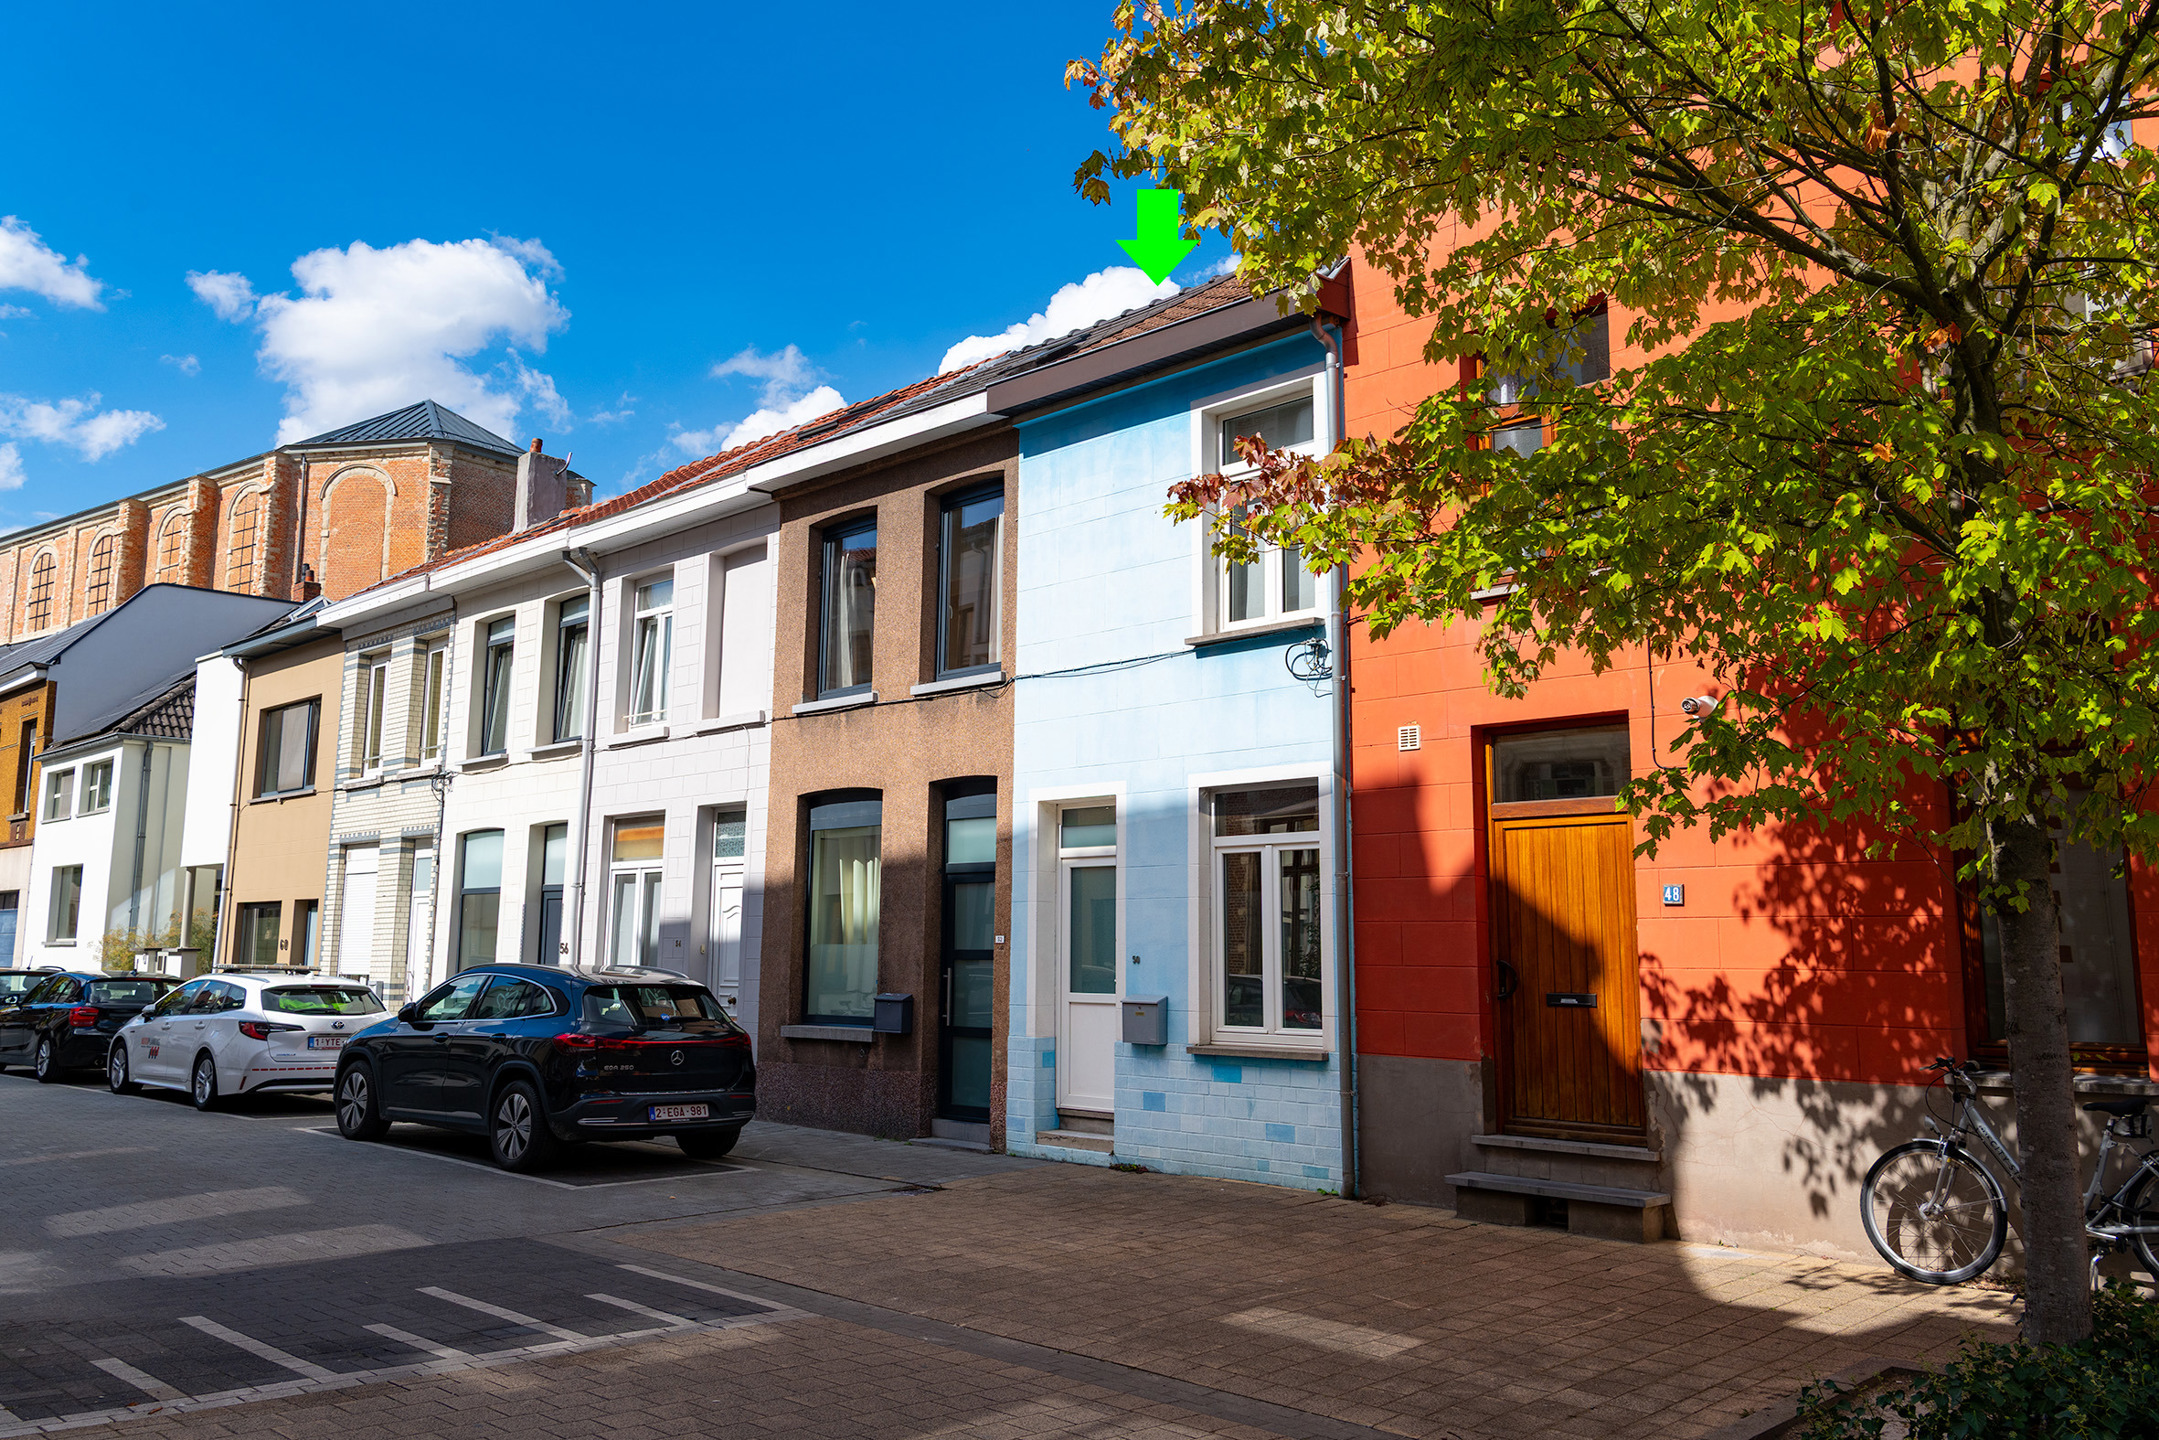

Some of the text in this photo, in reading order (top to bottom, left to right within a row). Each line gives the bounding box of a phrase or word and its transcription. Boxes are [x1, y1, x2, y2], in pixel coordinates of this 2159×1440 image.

[1664, 887, 1679, 901] 48
[280, 939, 289, 951] 60
[559, 942, 569, 955] 56
[655, 1105, 707, 1118] 2-EGA-981
[1990, 1140, 2009, 1161] CITY
